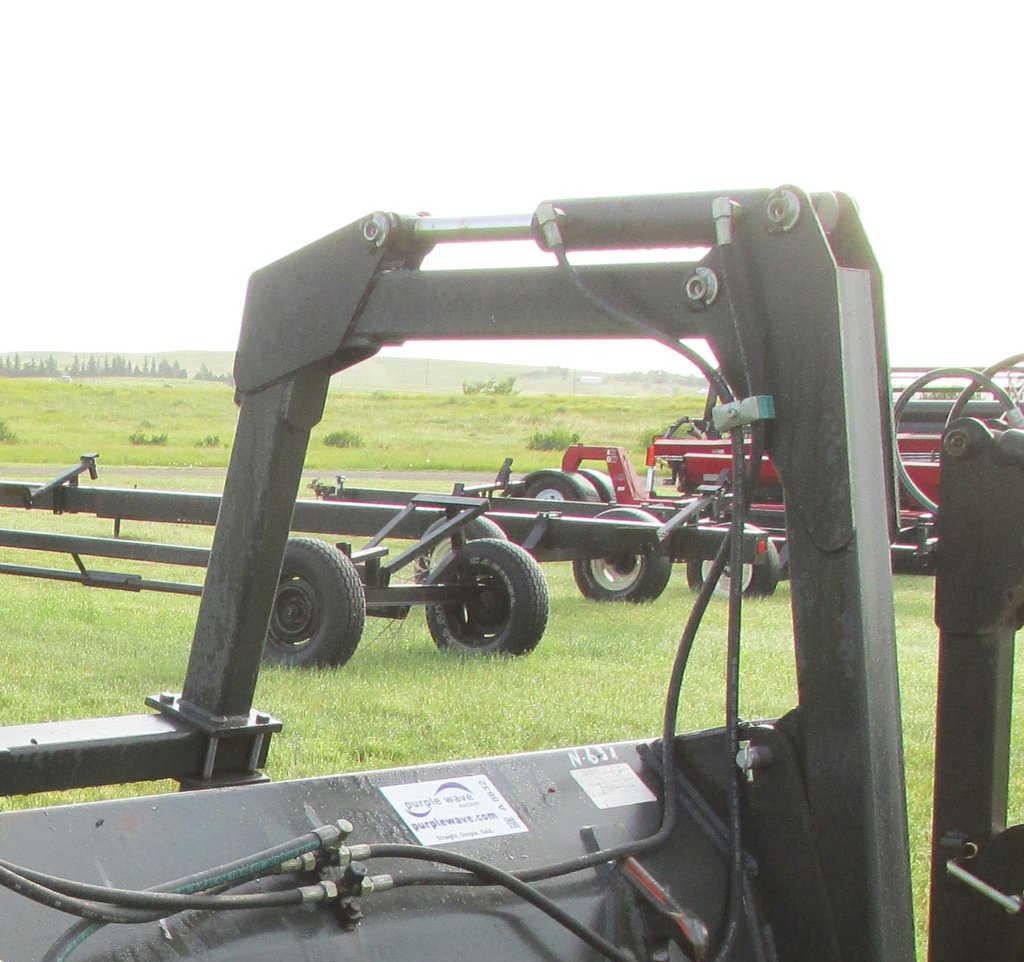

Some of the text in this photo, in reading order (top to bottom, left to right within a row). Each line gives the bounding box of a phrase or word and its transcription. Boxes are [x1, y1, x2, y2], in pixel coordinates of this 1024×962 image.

[404, 793, 475, 811] purple wave
[410, 812, 498, 832] purplewave.com
